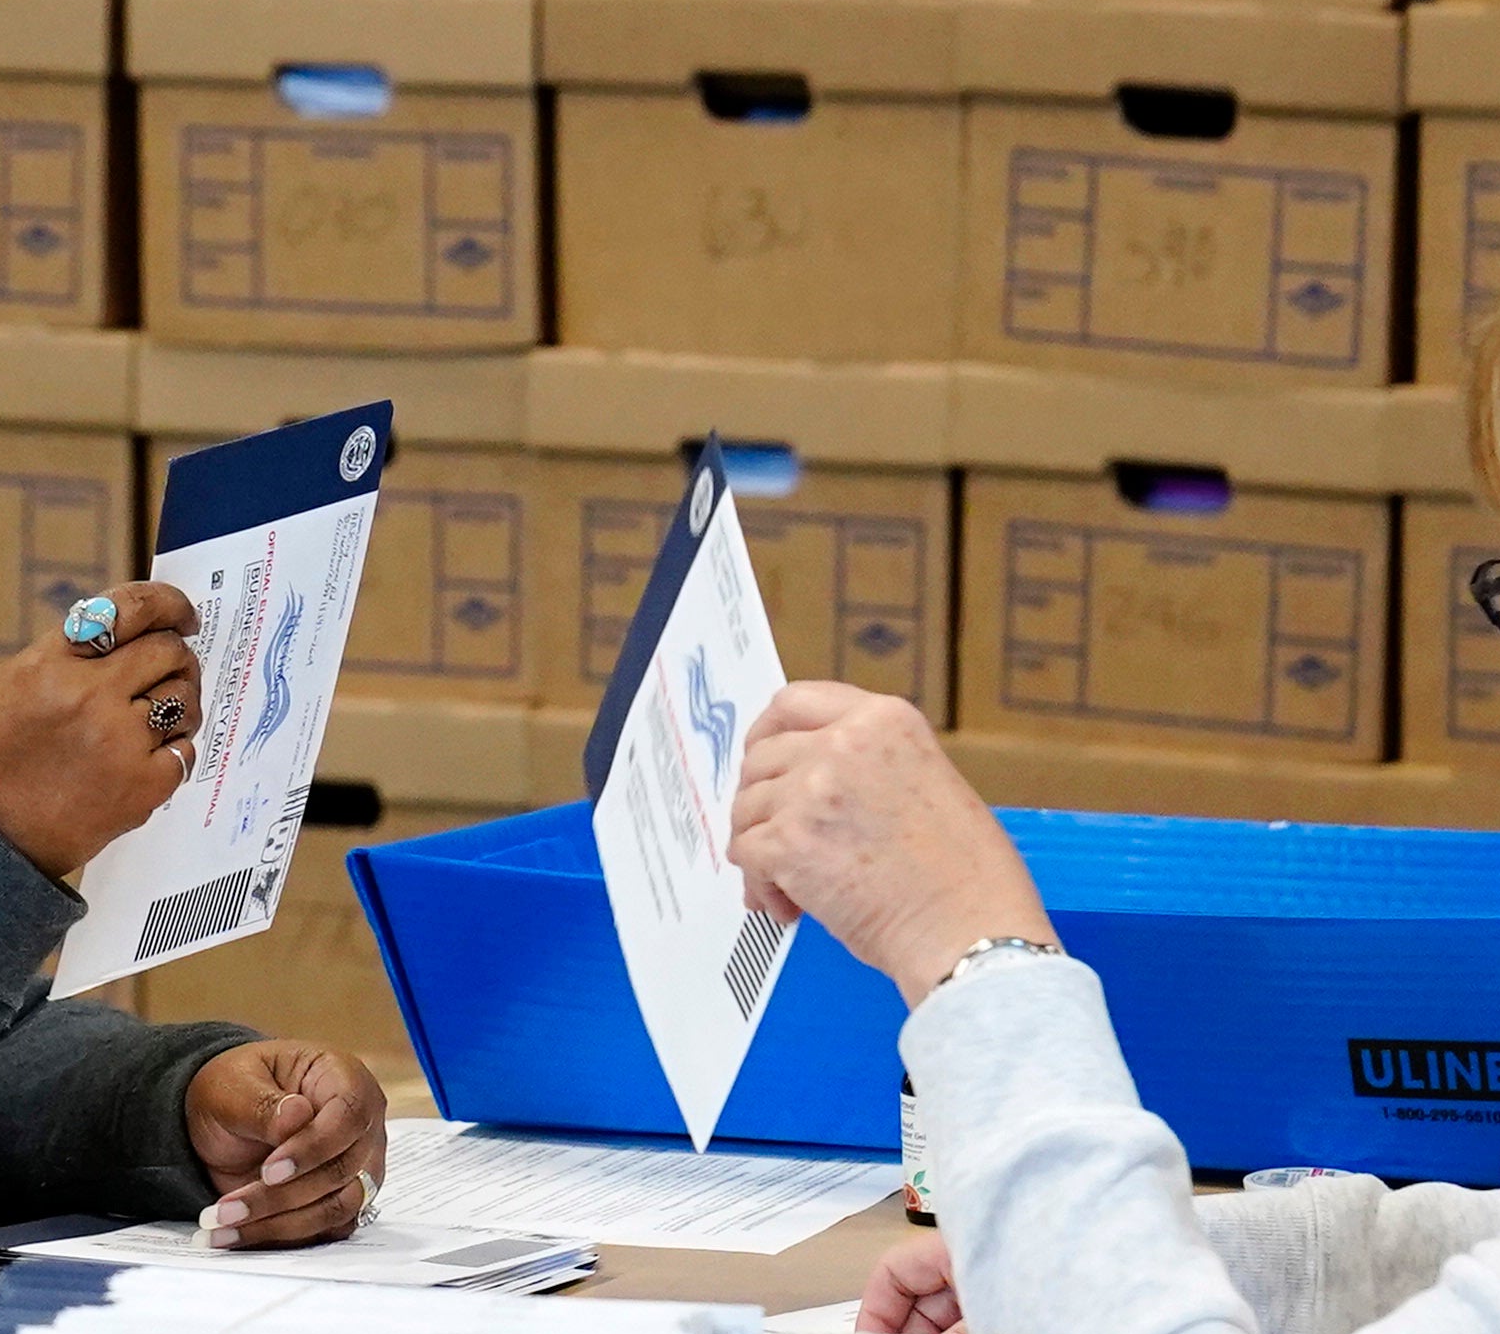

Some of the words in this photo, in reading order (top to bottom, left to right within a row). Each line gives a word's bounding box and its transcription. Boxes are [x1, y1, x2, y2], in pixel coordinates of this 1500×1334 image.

[264, 530, 276, 593] OFFICIAL
[200, 621, 211, 646] BOX
[204, 600, 213, 618] PO
[205, 597, 222, 654] CHESTER
[233, 567, 262, 662] BUSINESS
[245, 601, 267, 668] ELECTION
[219, 668, 241, 726] REPLY
[227, 670, 251, 746] BALLOTING
[205, 732, 226, 777] MAIL
[204, 752, 231, 827] MATERIALS
